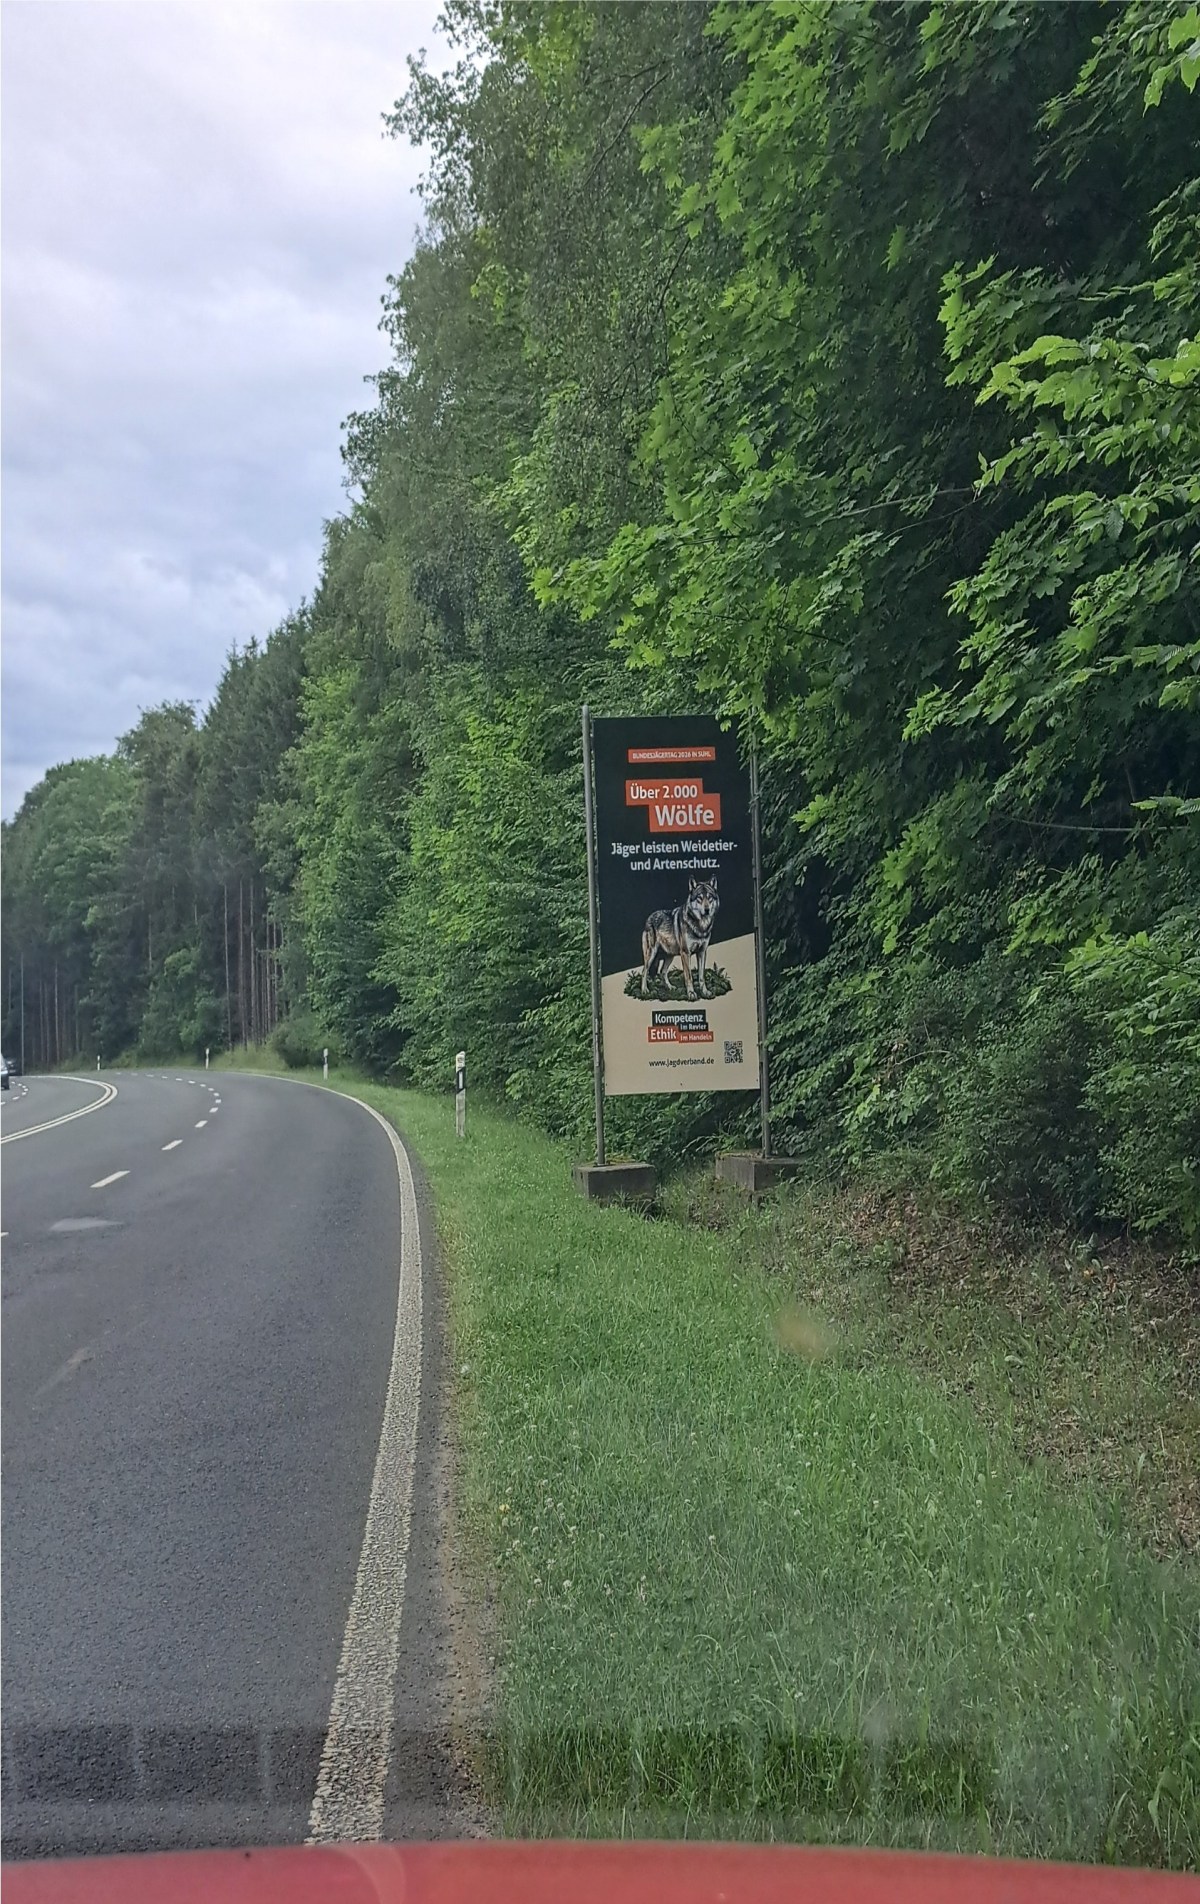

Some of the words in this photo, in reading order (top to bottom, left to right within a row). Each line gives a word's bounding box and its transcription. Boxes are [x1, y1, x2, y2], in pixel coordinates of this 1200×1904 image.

[630, 783, 660, 799] Über
[663, 785, 697, 798] 2.000
[655, 804, 715, 826] Wölfe
[611, 842, 640, 858] Jäger
[642, 841, 679, 854] leisten
[681, 839, 738, 852] Weidetier-
[630, 858, 651, 871] und
[653, 857, 720, 870] Artenschutz.
[655, 1013, 703, 1025] Kompetenz
[650, 1028, 677, 1040] Ethik
[649, 1057, 715, 1067] www.jagdverband.de
